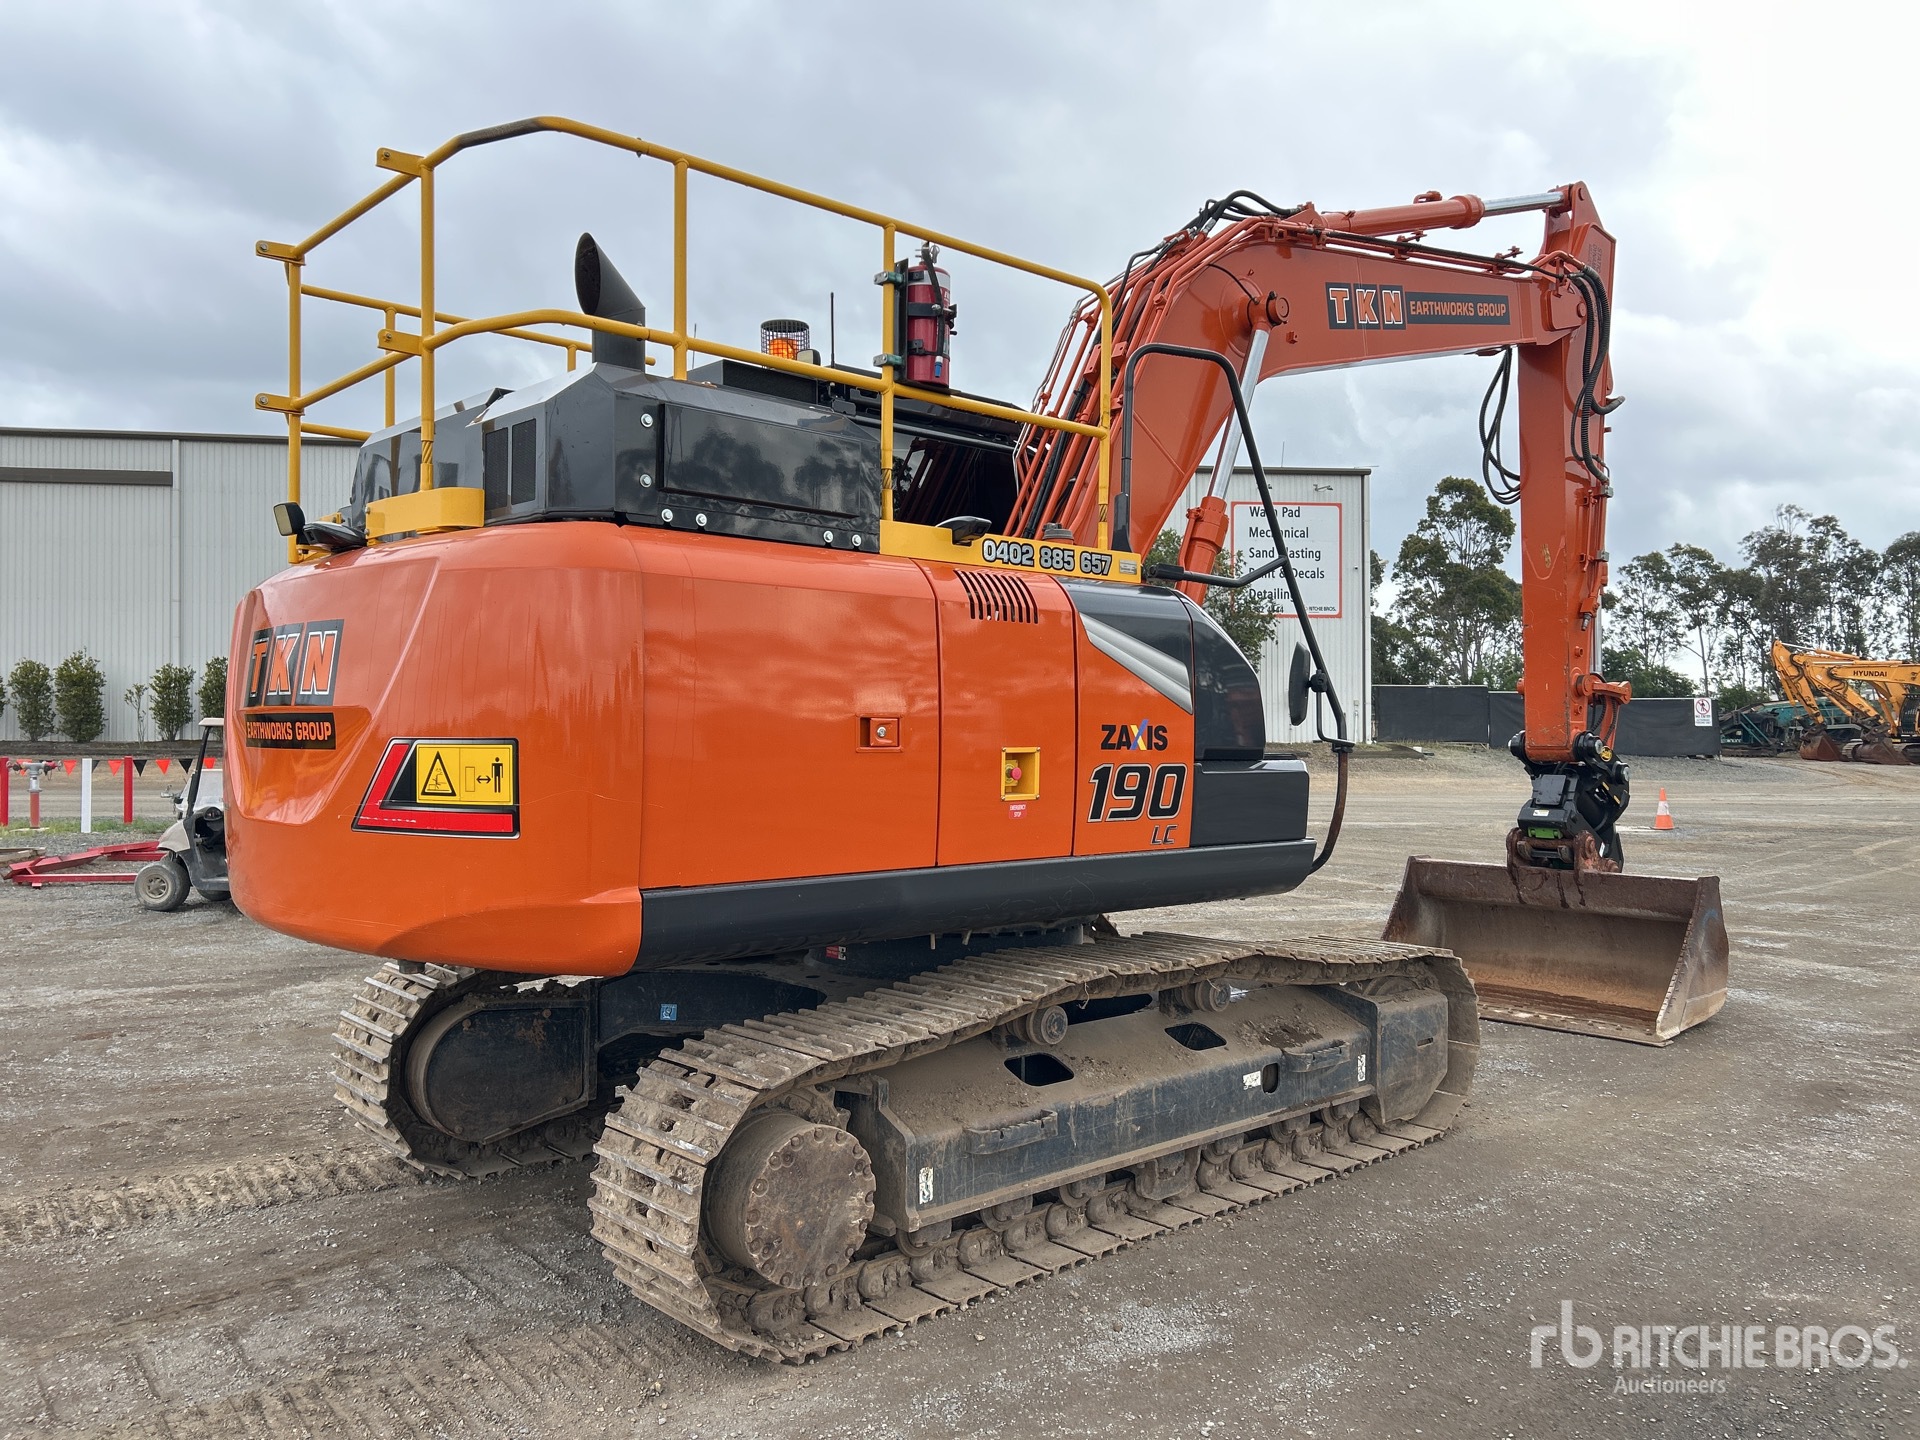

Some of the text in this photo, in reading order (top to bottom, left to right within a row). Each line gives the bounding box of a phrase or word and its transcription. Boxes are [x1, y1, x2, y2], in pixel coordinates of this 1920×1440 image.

[1329, 288, 1507, 324] TKN EARTHWORKS GROUP
[1249, 506, 1301, 518] Wa Pad
[1249, 527, 1309, 538] Mecnical
[982, 538, 1034, 567] 0402
[1039, 545, 1075, 572] 885
[1079, 551, 1112, 577] 657
[1249, 547, 1321, 561] Sand lasting
[1292, 567, 1325, 579] Decals
[1249, 588, 1297, 603] Detailin
[250, 630, 338, 697] TKN
[246, 721, 332, 741] EARTHWORKS GROUP
[1101, 719, 1168, 751] ZAXIS
[1087, 763, 1188, 823] 190
[1151, 824, 1178, 845] LC
